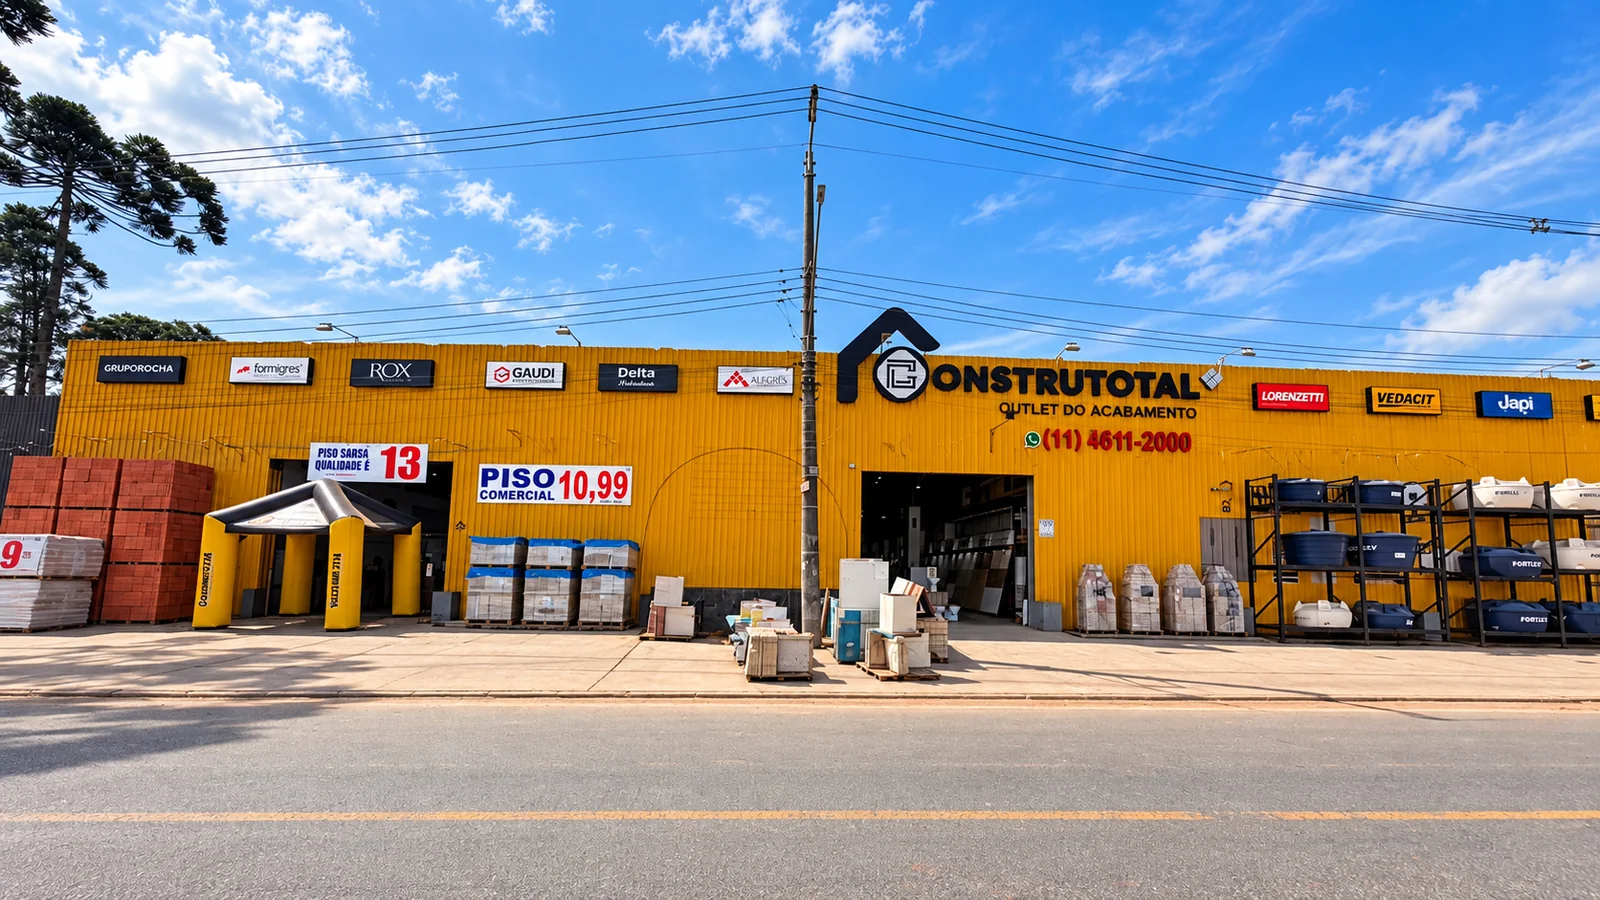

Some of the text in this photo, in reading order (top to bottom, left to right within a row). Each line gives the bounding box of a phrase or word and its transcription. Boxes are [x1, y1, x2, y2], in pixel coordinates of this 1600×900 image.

[104, 364, 173, 373] GRUPOROCHA
[370, 363, 412, 381] ROX
[512, 367, 555, 378] GAUDI
[618, 367, 655, 378] Delta
[1261, 391, 1324, 403] LORENZETTI
[1377, 392, 1435, 405] VEDACIT
[1497, 394, 1534, 412] Japi
[1000, 402, 1197, 419] OUTLET DO ACABAMENTO
[1042, 428, 1192, 453] (11) 4611-2000
[318, 447, 338, 458] PISO
[315, 460, 361, 471] QUALIDADE
[380, 446, 421, 480] 13
[481, 468, 556, 489] PISO
[559, 470, 629, 504] 10,99
[479, 490, 555, 501] COMERCIAL
